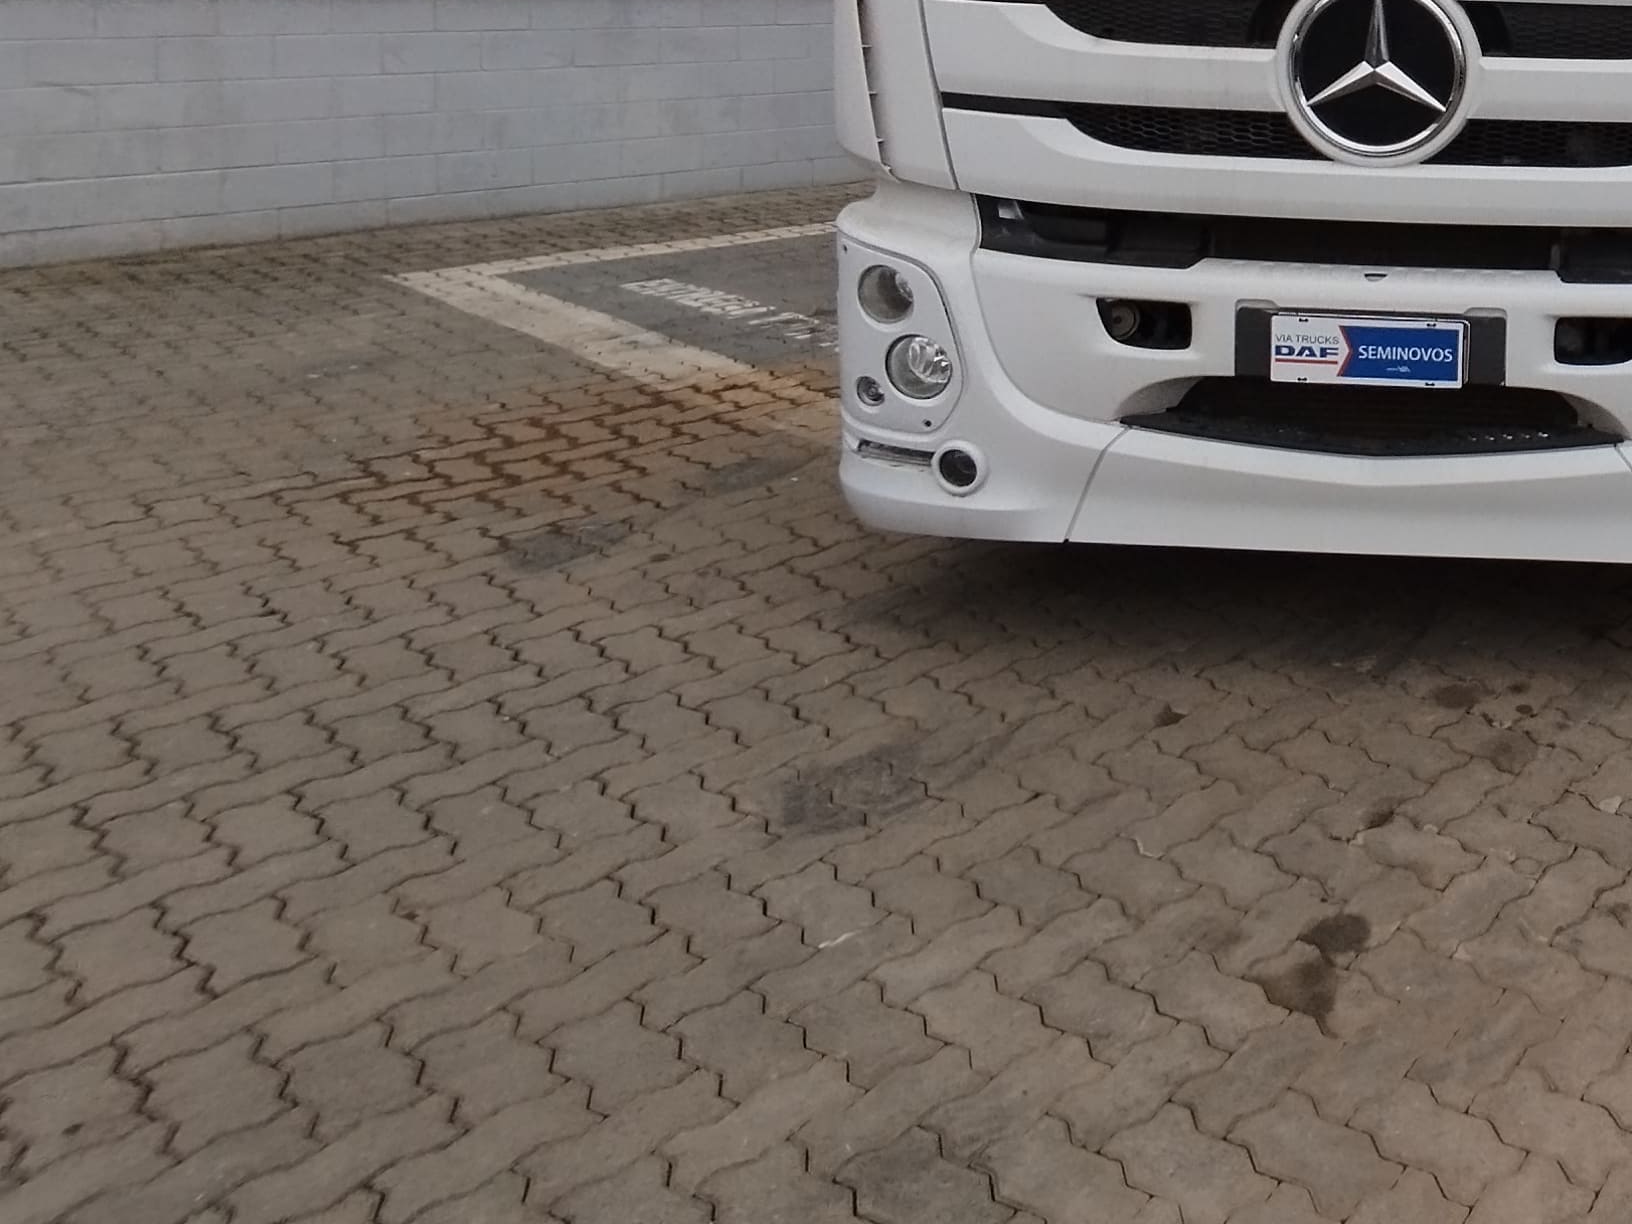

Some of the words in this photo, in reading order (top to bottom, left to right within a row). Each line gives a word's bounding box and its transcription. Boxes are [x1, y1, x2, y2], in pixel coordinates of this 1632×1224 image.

[1275, 334, 1293, 343] VIA
[1296, 334, 1339, 345] TRUCKS
[1275, 345, 1339, 358] DAF
[1358, 344, 1453, 363] SEMINOVOS
